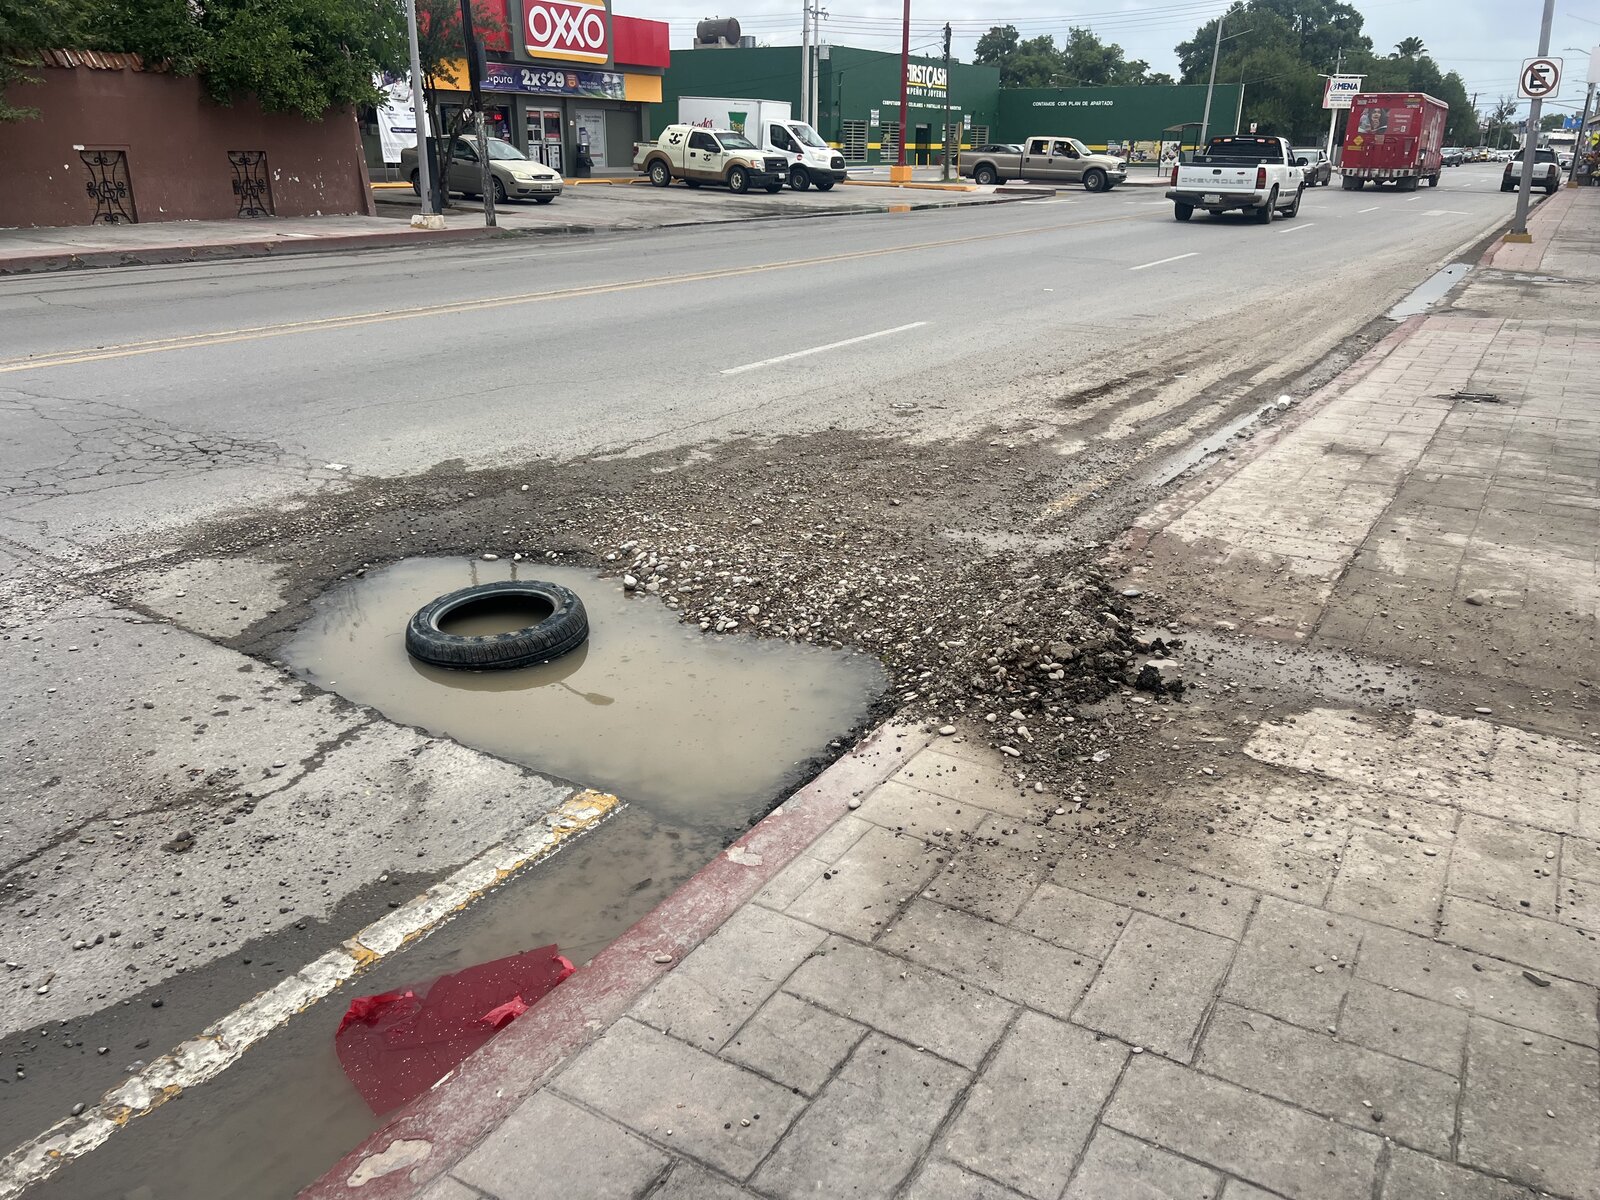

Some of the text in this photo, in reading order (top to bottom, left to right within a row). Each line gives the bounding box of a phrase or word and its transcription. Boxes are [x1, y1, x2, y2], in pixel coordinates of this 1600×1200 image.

[528, 5, 604, 48] OXXO
[1337, 82, 1358, 90] MENA
[1181, 177, 1252, 185] CHEVROLET
